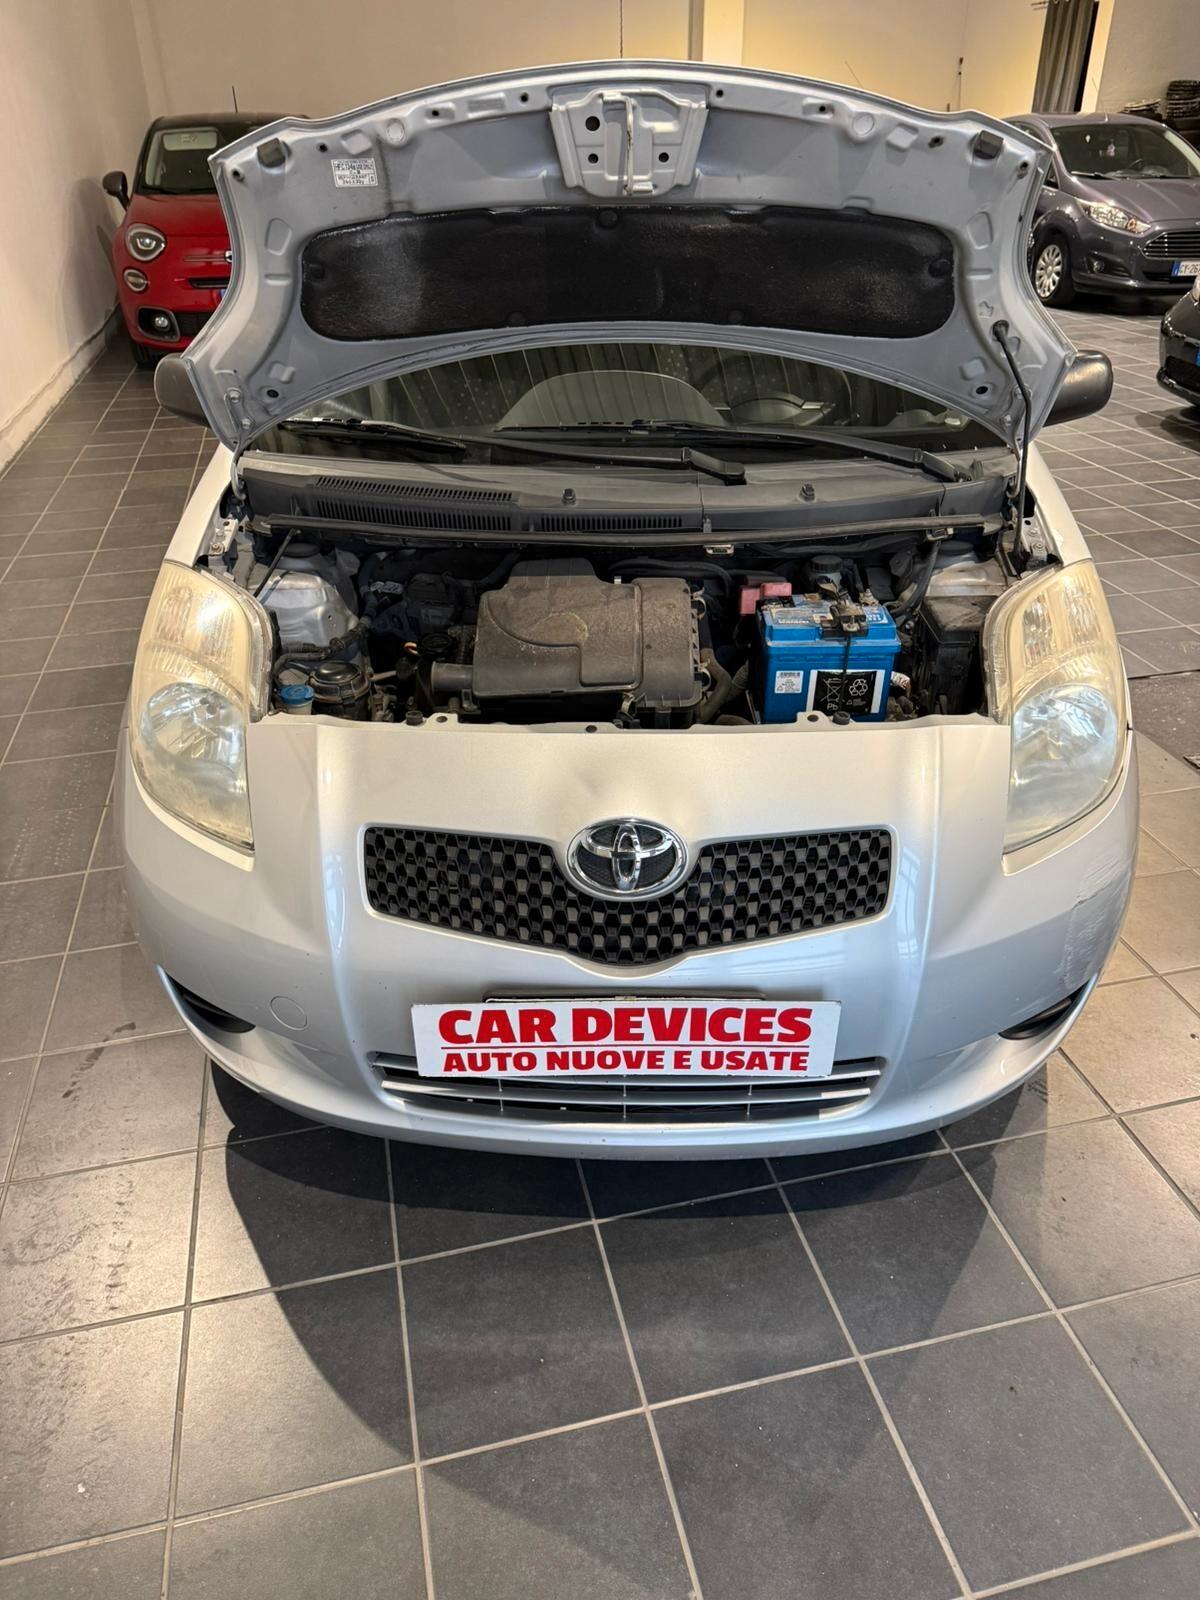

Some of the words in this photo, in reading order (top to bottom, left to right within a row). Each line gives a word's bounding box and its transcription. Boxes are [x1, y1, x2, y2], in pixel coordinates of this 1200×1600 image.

[827, 703, 839, 711] Pb
[438, 1009, 557, 1044] CAR
[572, 1007, 813, 1043] DEVICES
[443, 1051, 537, 1072] AUTO
[546, 1050, 665, 1071] NUOVE
[673, 1050, 692, 1070] E
[701, 1051, 809, 1072] USATE
